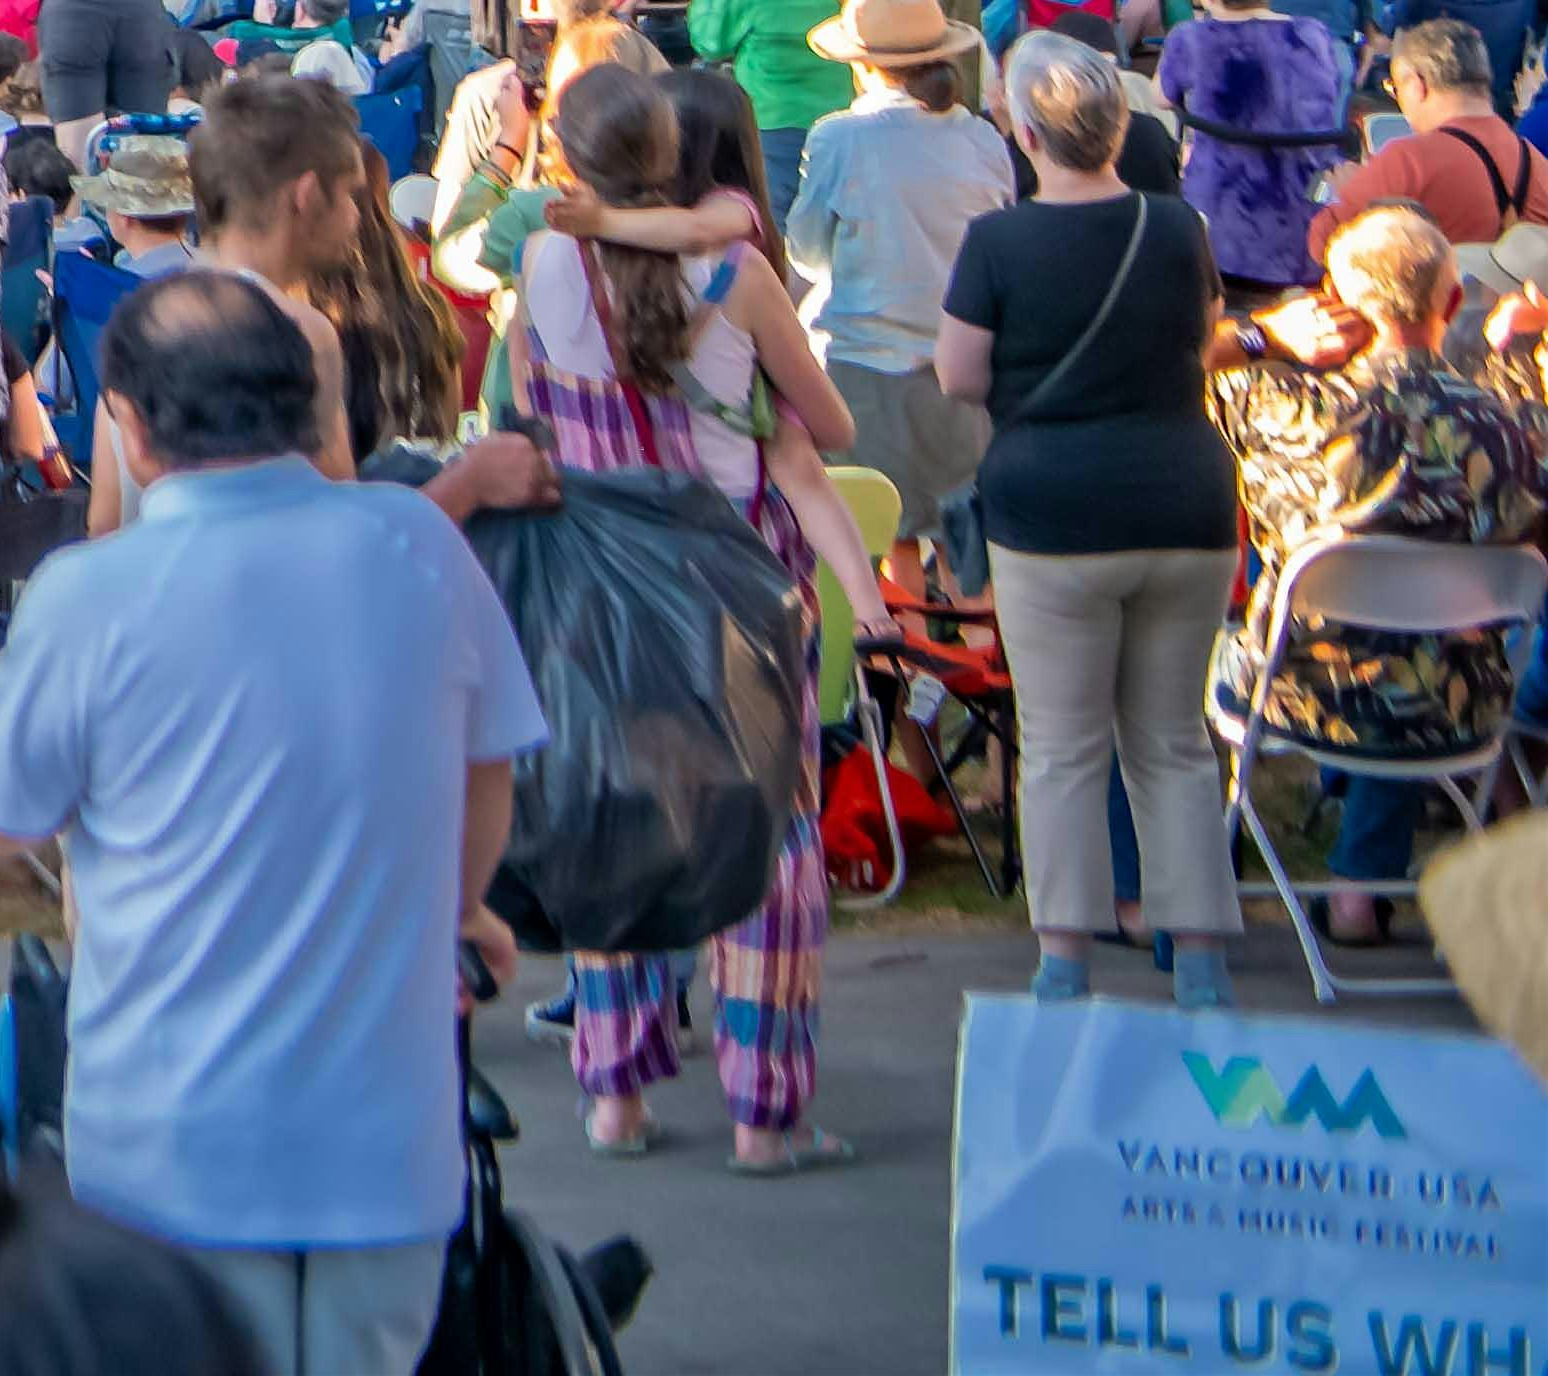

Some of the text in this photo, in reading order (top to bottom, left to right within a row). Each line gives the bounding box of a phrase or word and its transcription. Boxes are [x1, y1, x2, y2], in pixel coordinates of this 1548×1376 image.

[1117, 1139, 1503, 1212] VANCOUVER USA
[1120, 1196, 1198, 1228] ARTS
[1237, 1209, 1333, 1241] MUSIC
[1354, 1220, 1501, 1260] FESTIVAL
[982, 1264, 1548, 1376] TELL US WH
